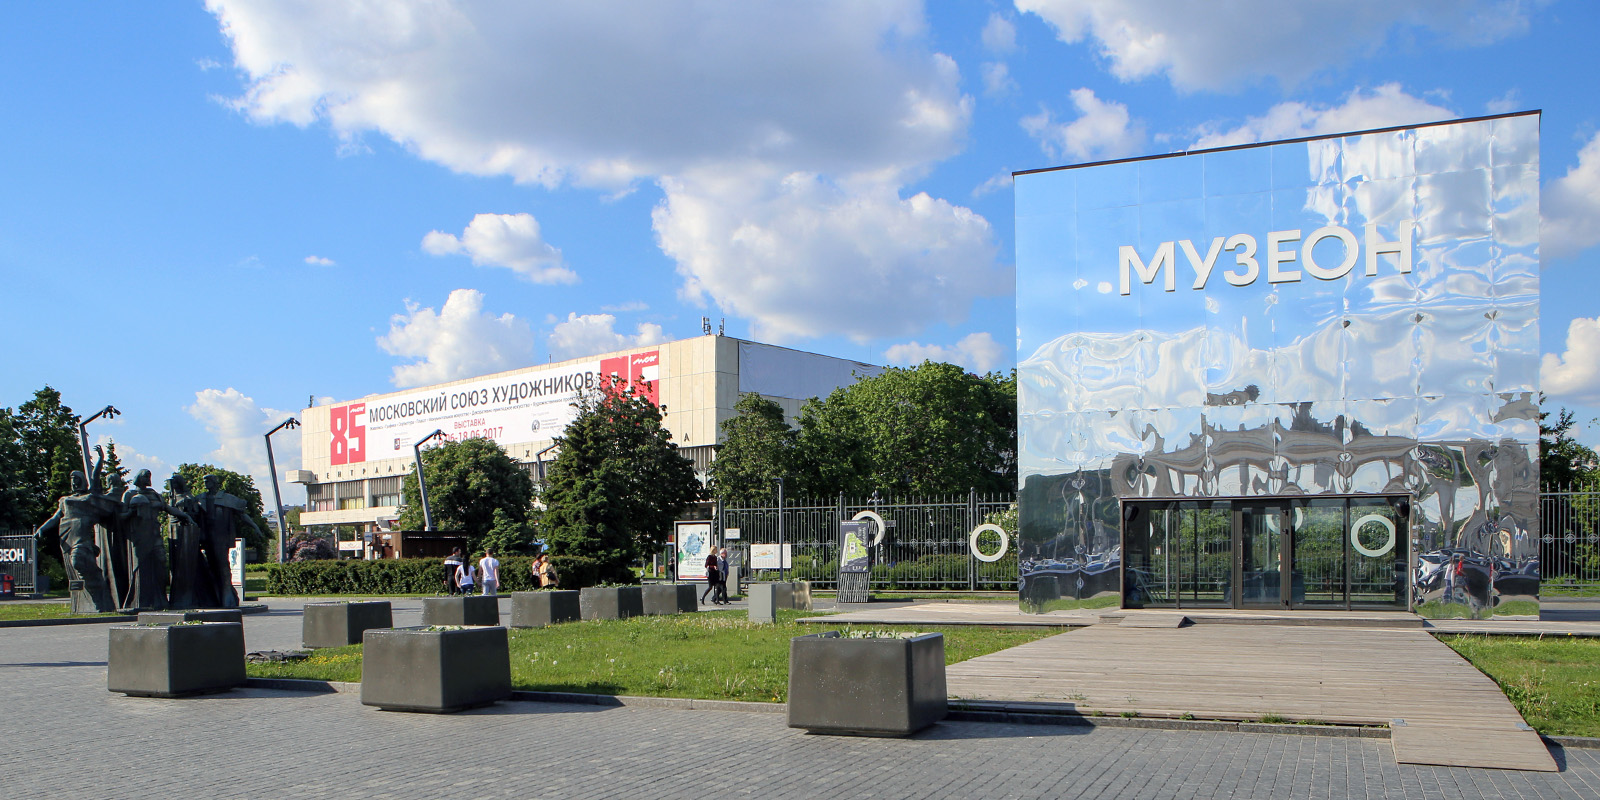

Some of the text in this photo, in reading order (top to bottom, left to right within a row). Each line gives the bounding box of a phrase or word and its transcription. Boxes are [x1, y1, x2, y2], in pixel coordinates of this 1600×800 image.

[1118, 219, 1413, 296] МУЗЕОН
[369, 371, 594, 423] МОСКОВСКИЙ СОЮЗ ХУДОЖНИКОВ
[454, 418, 486, 430] ВЫСТАВКА
[330, 403, 366, 466] 85
